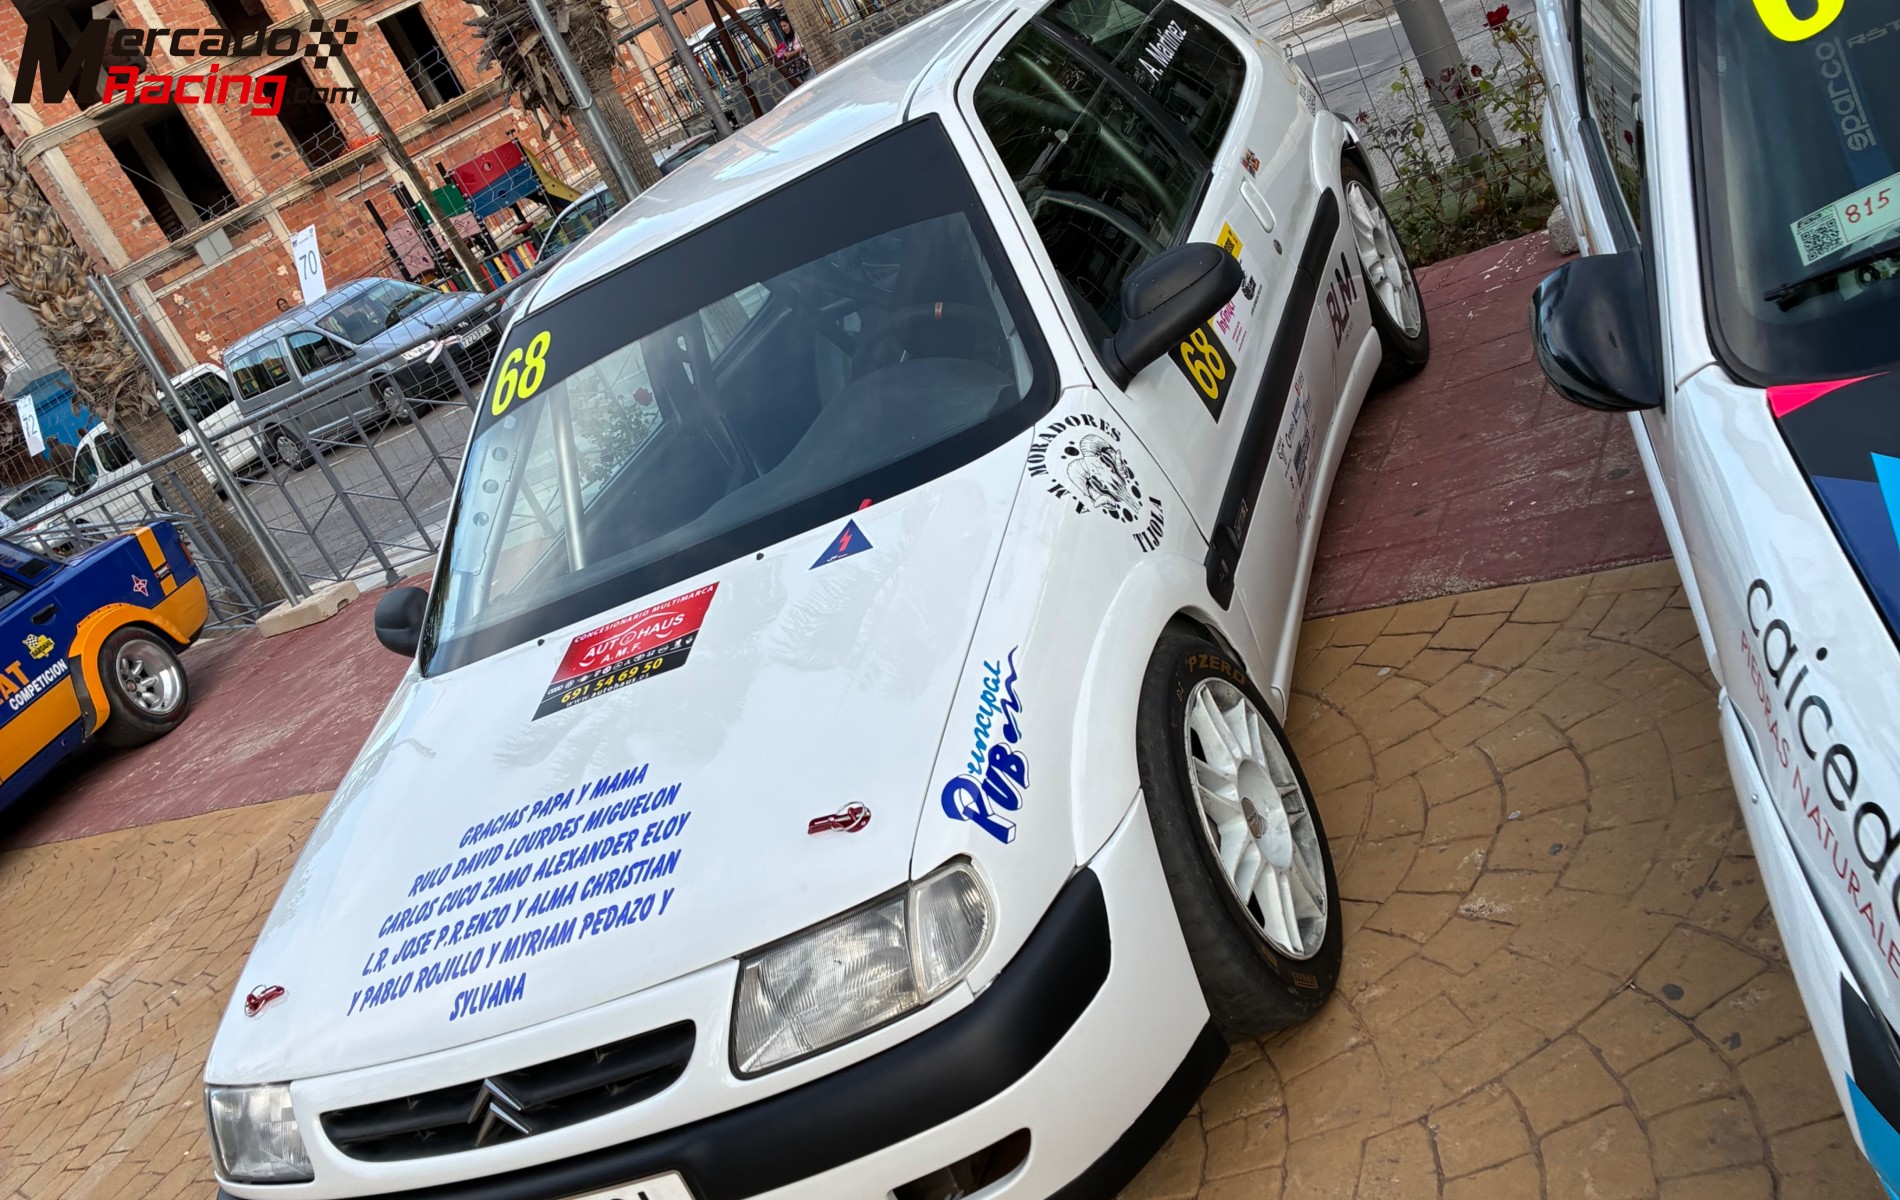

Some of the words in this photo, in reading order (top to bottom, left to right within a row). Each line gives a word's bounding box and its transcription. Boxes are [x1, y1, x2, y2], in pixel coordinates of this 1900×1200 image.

[1138, 57, 1163, 82] A.
[1845, 187, 1892, 224] 815
[298, 249, 318, 280] 70
[491, 330, 551, 416] 68
[1180, 328, 1226, 400] 68
[1027, 413, 1122, 478] MORADORES
[1132, 496, 1165, 553] TIJOLA
[574, 609, 650, 643] CONCESIONARIO
[651, 585, 715, 613] MULTIMARCA
[0, 659, 30, 706] AT
[8, 658, 68, 711] COMPETICION
[561, 685, 591, 704] 691
[593, 673, 615, 692] 54
[617, 666, 640, 682] 69
[641, 657, 664, 675] 50
[600, 643, 642, 664] A.M.F.
[565, 672, 650, 708] www.autohaus.es
[1740, 630, 1791, 768] PIEDRAS
[1747, 578, 1900, 925] caiced
[459, 805, 529, 848] GRACIAS
[528, 788, 575, 823] PAPA
[576, 782, 591, 805] Y
[590, 763, 649, 800] MAMA
[408, 867, 451, 897] RULO
[451, 844, 503, 880] DAVID
[504, 814, 584, 860] LOURDES
[582, 783, 681, 833] MIGUELON
[378, 897, 439, 938] CARLOS
[438, 881, 482, 917] CUCO
[481, 863, 533, 899] ZAMO
[533, 828, 639, 882] ALEXANDER
[641, 812, 691, 847] ELOY
[392, 935, 435, 965] JOSE
[511, 898, 528, 923] Y
[526, 881, 578, 918] ALMA
[580, 849, 682, 901] CHRISTIAN
[347, 991, 362, 1016] Y
[360, 976, 413, 1012] PABLO
[414, 947, 485, 994] ROJILLO
[486, 941, 501, 968] Y
[500, 917, 577, 963] MYRIAM
[578, 897, 653, 939] PEDAZO
[658, 888, 674, 915] Y
[450, 972, 526, 1021] SYLVANA
